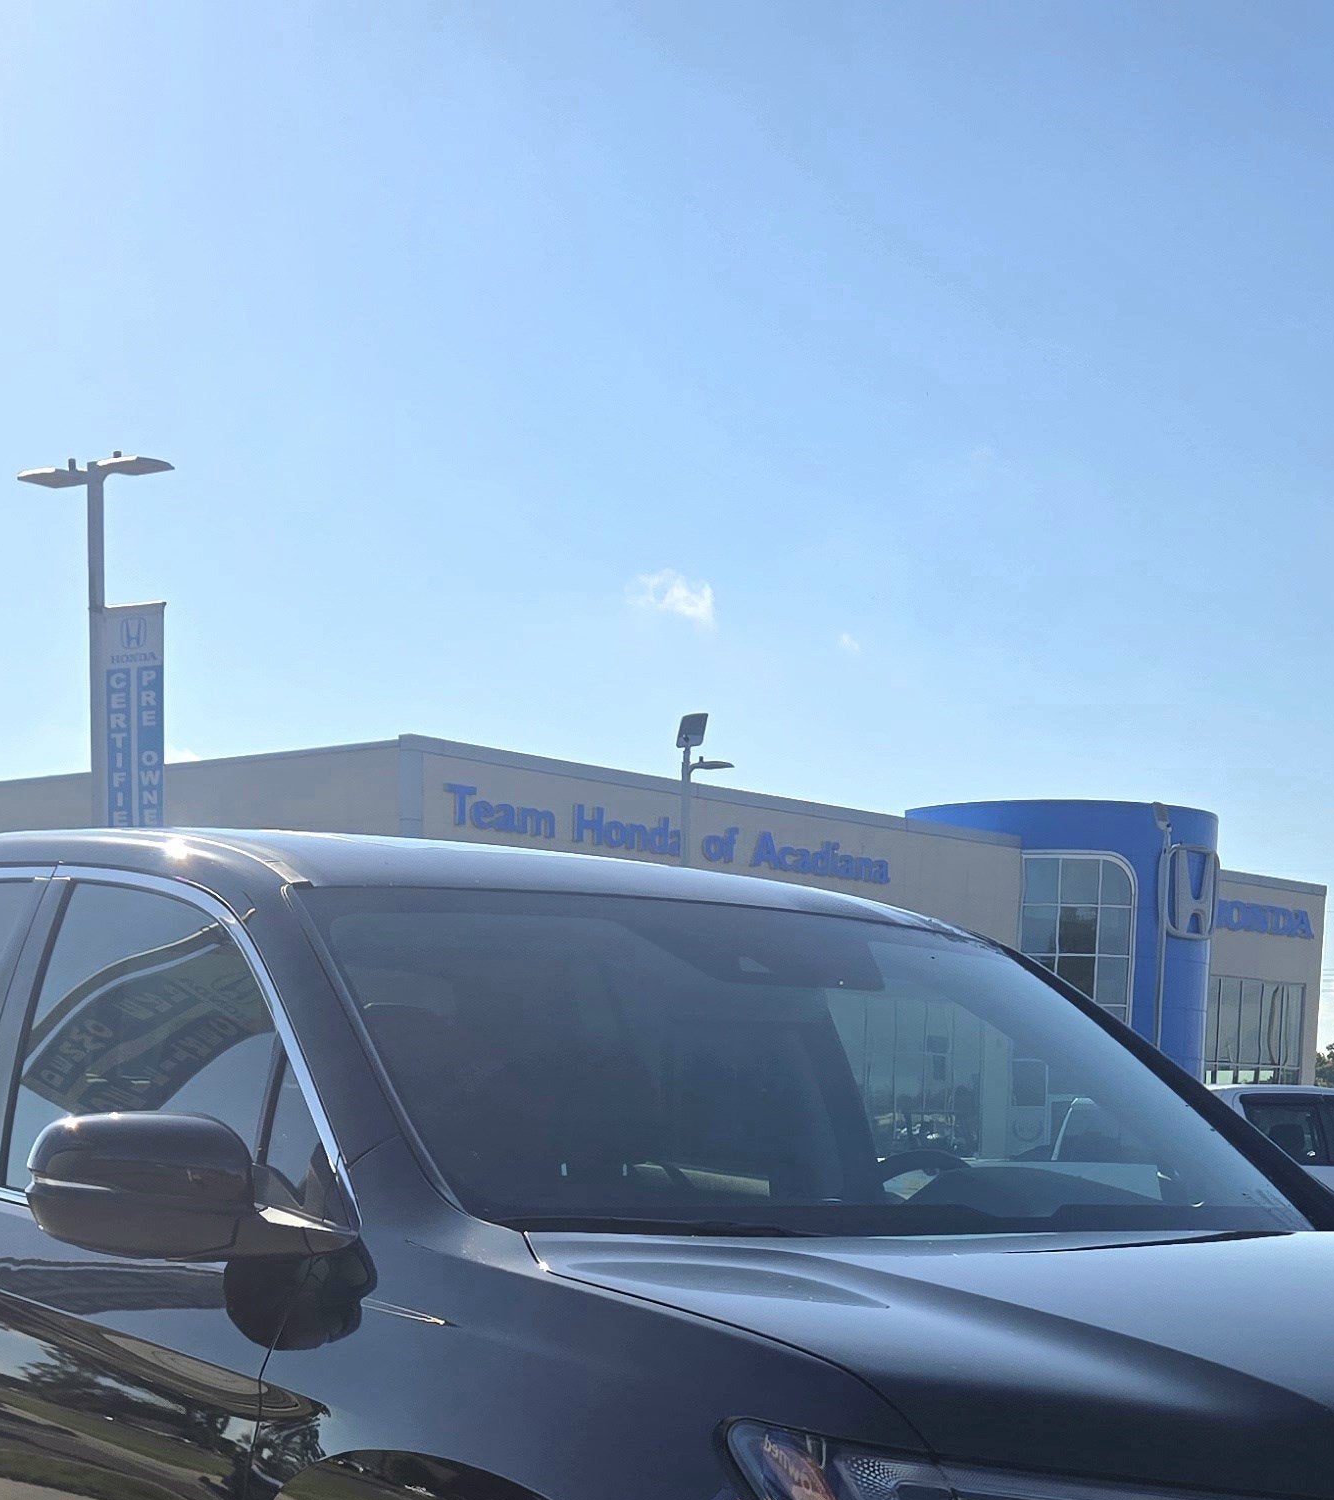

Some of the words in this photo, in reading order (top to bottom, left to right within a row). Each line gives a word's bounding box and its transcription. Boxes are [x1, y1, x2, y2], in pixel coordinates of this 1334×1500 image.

[110, 652, 157, 664] HONDA
[141, 670, 157, 727] PRE
[109, 672, 129, 827] CERTIFIE
[139, 750, 160, 827] OWNE
[443, 782, 555, 838] Team
[571, 803, 681, 856] Honda
[700, 827, 739, 863] of
[747, 832, 891, 885] Acadiana
